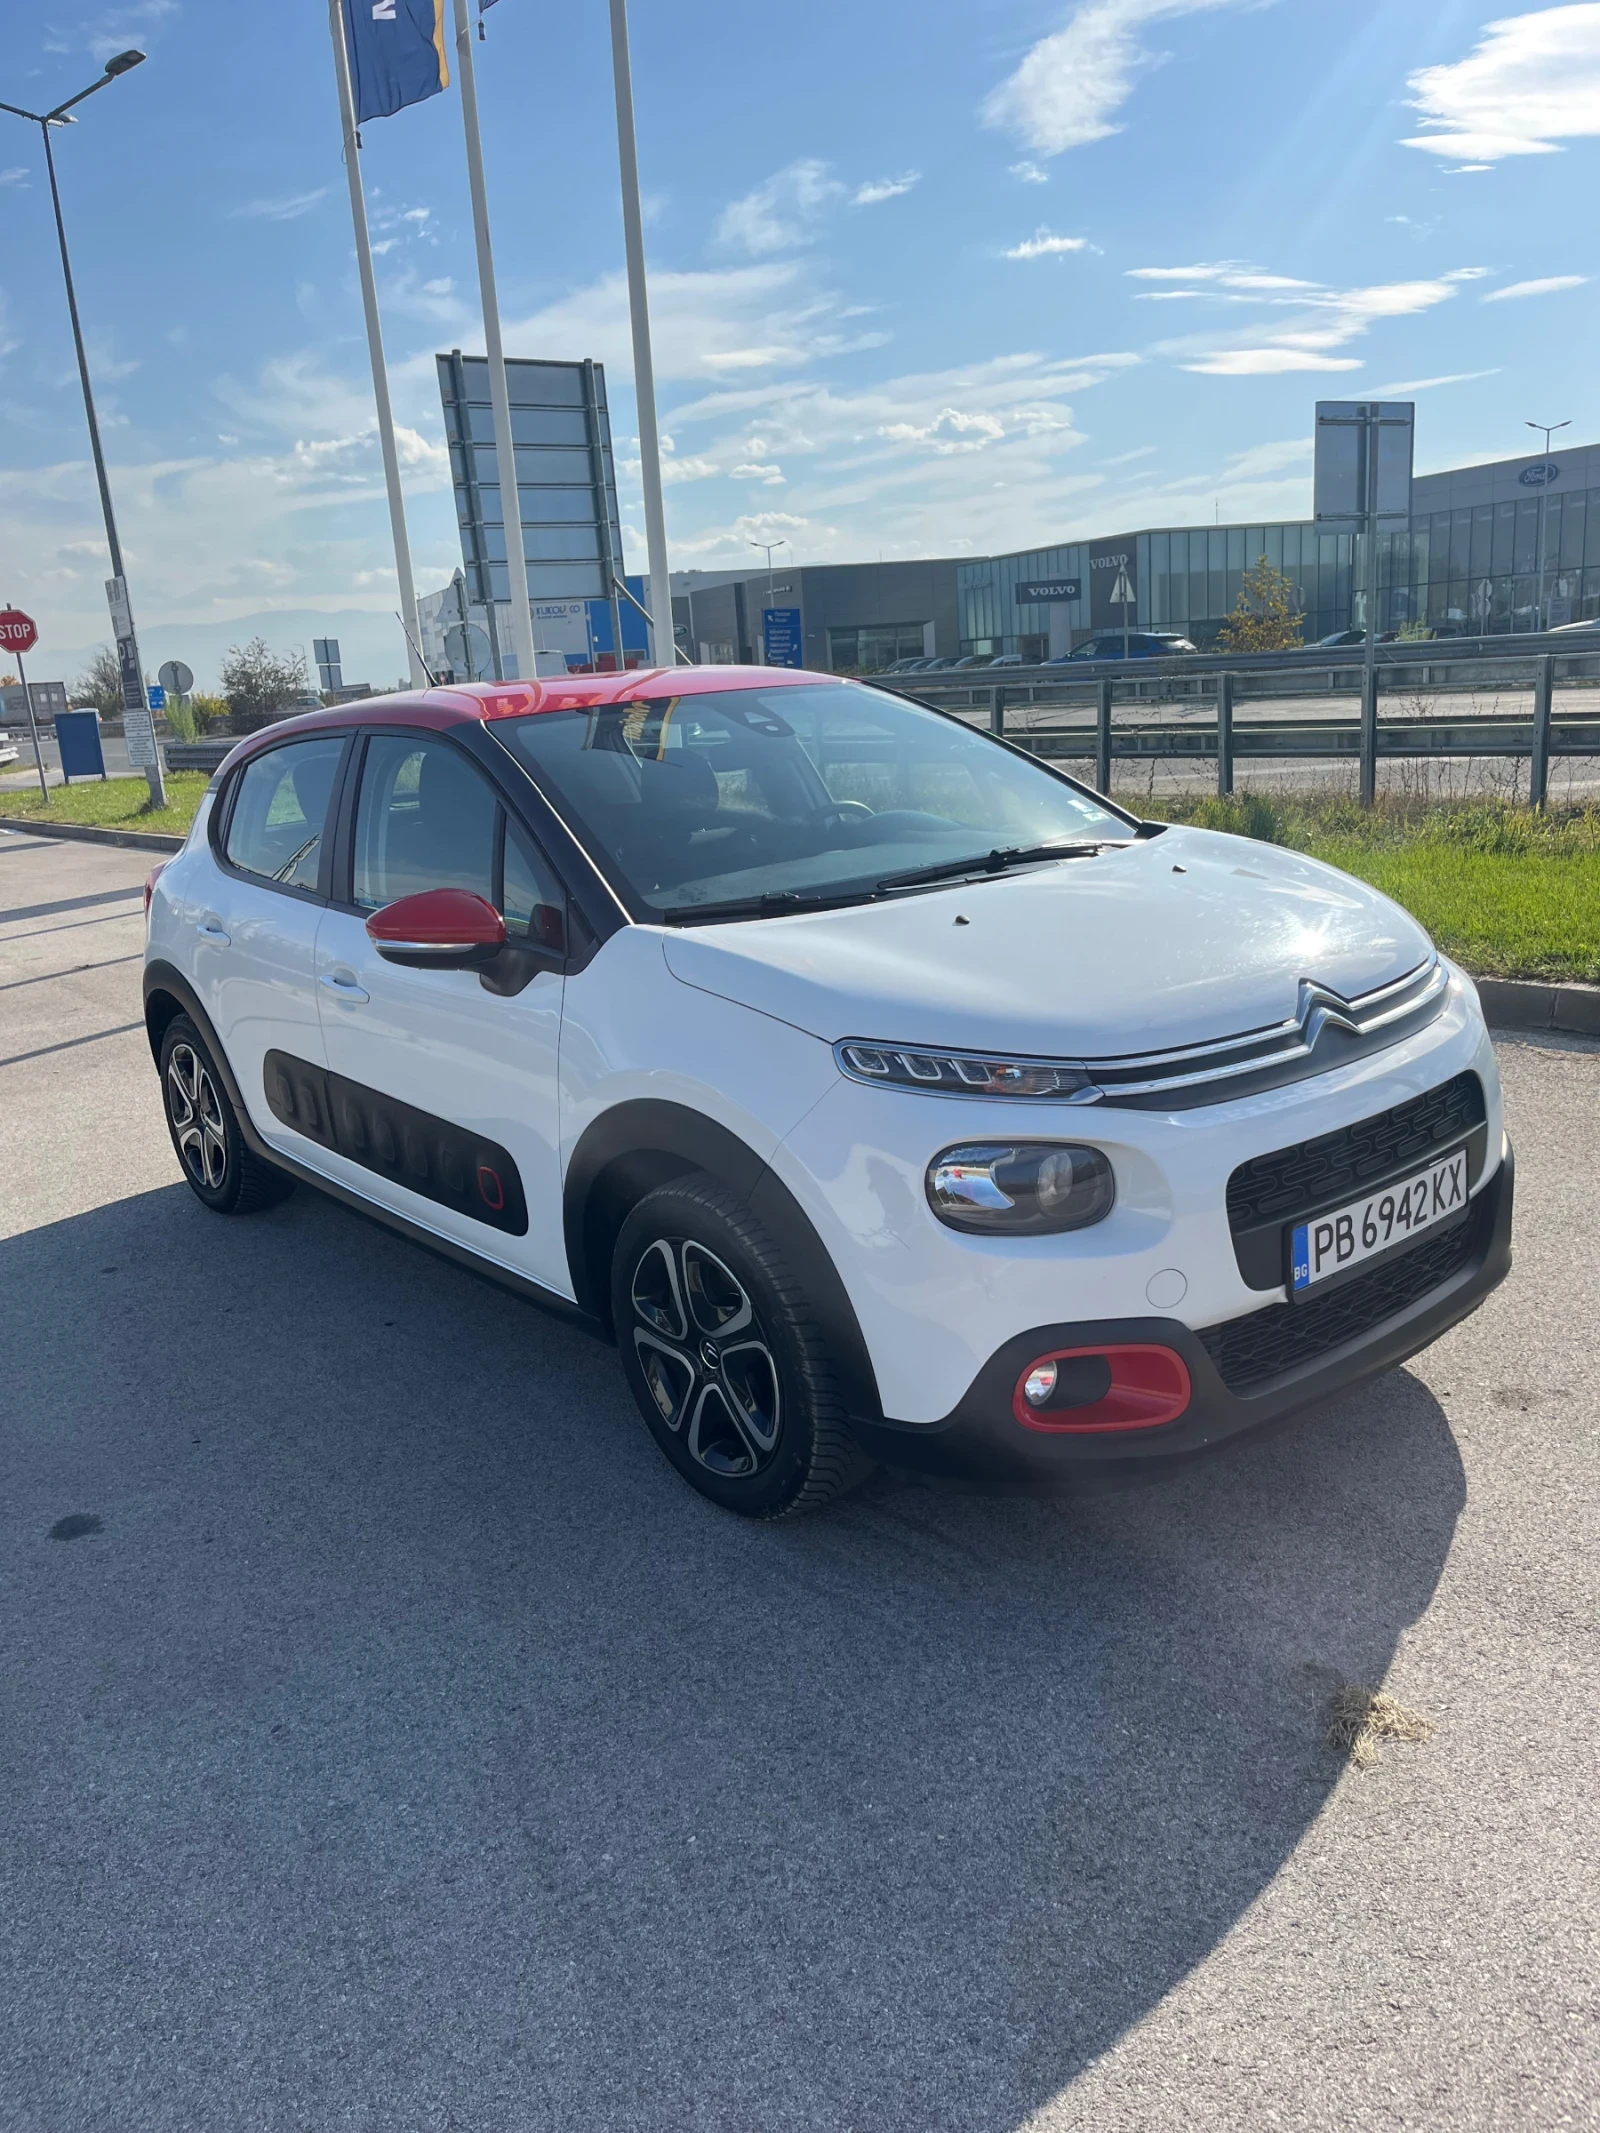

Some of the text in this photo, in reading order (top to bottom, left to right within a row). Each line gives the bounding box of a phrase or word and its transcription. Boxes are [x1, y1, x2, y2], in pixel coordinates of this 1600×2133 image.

[1090, 554, 1128, 570] VOLVO
[1028, 585, 1076, 596] VOLVO
[0, 623, 31, 640] STOP
[1314, 1214, 1355, 1273] PB
[1362, 1179, 1428, 1249] 6942
[1293, 1263, 1308, 1281] BG
